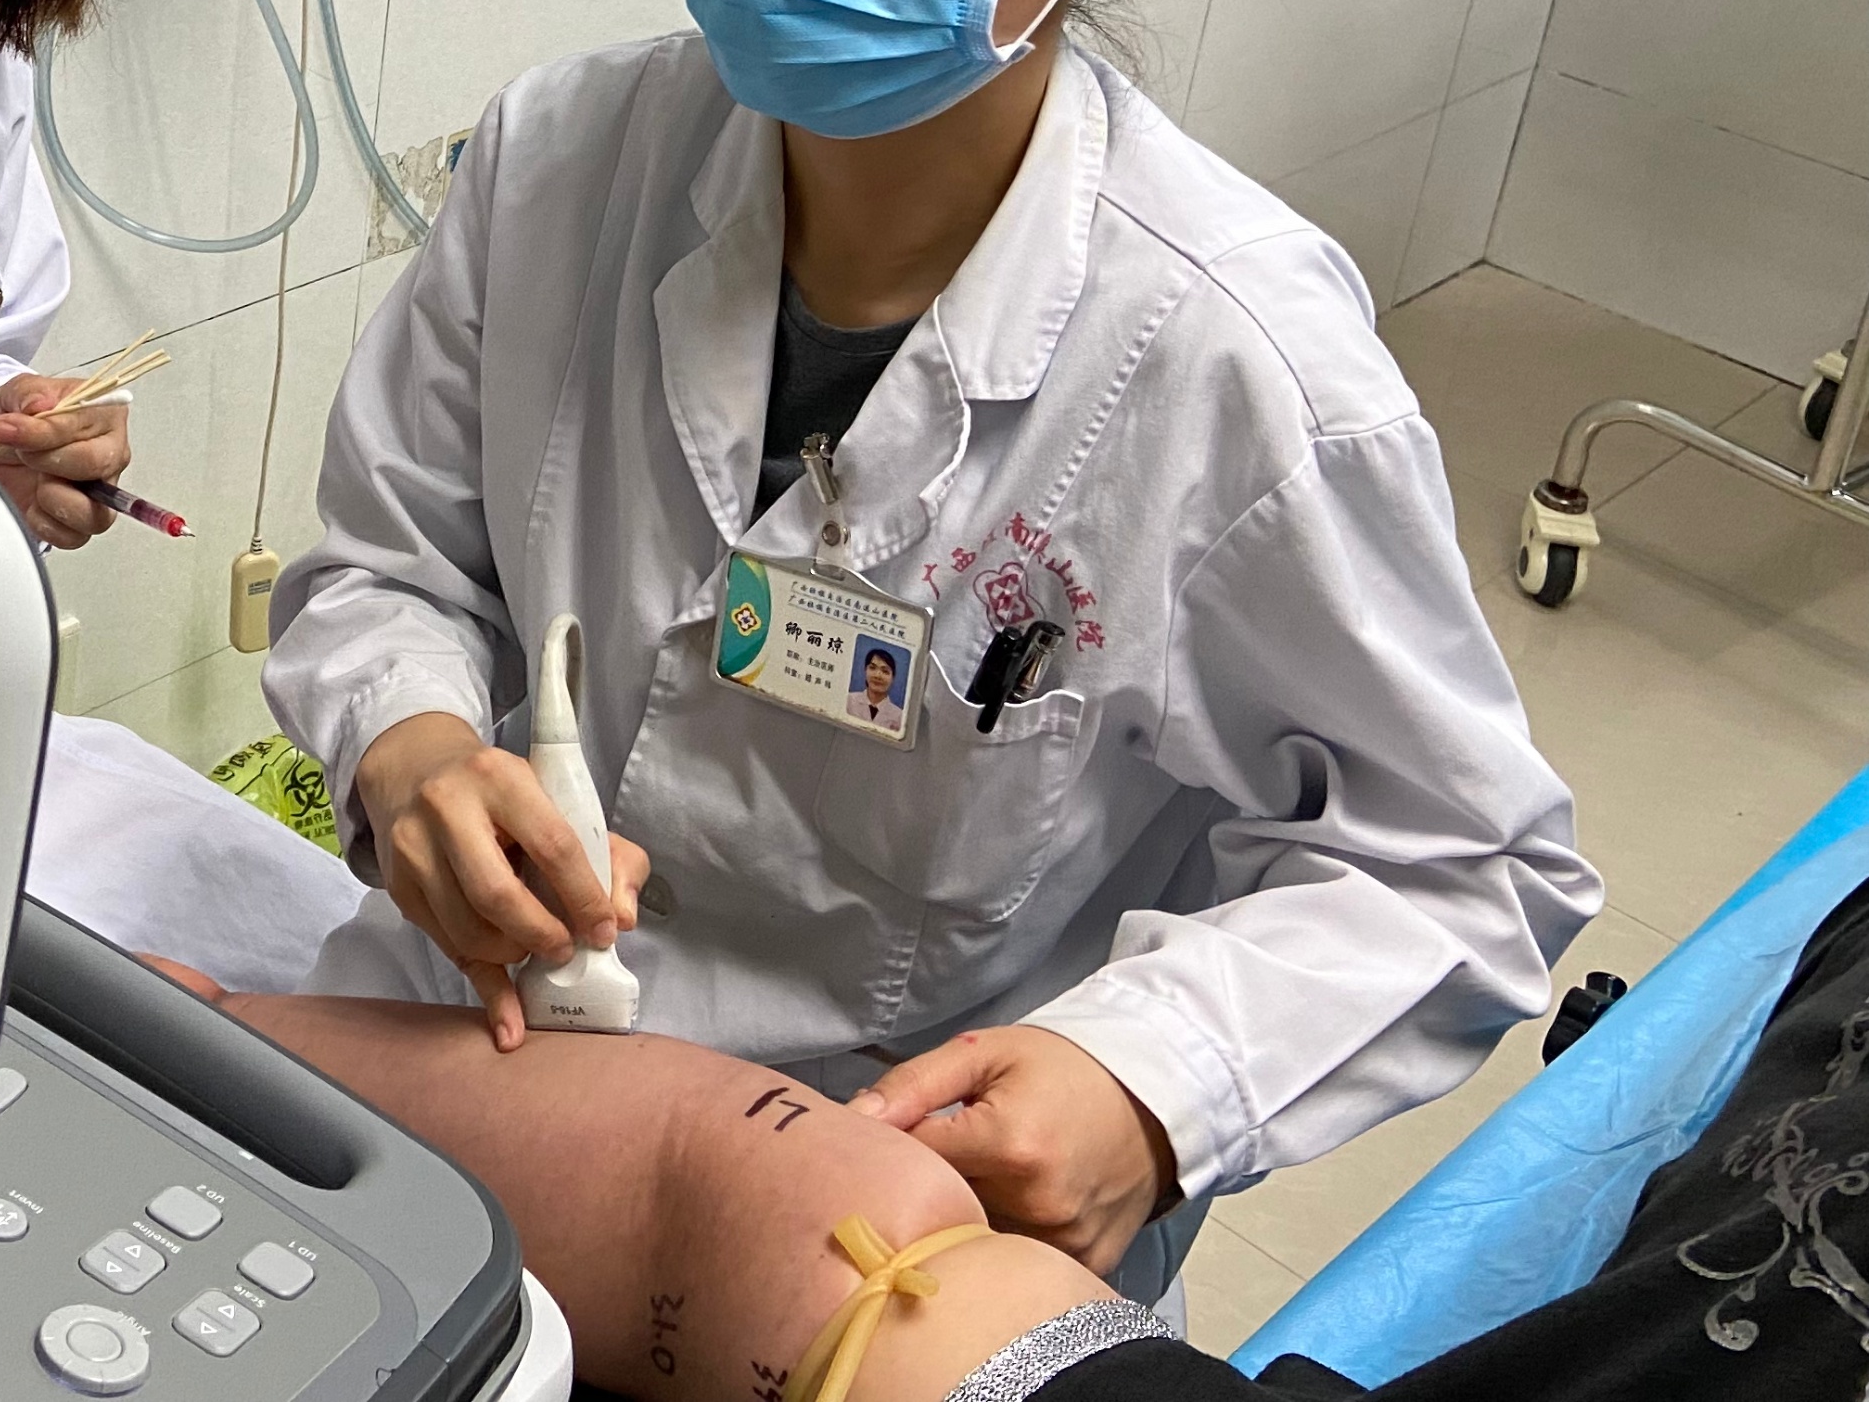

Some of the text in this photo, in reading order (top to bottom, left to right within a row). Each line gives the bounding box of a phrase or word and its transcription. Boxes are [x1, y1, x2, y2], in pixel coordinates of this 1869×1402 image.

[9, 1189, 44, 1215] Invert
[196, 1184, 227, 1204] UD 2
[132, 1220, 182, 1254] Baseline
[297, 1246, 318, 1262] UD
[233, 1283, 266, 1309] Scale
